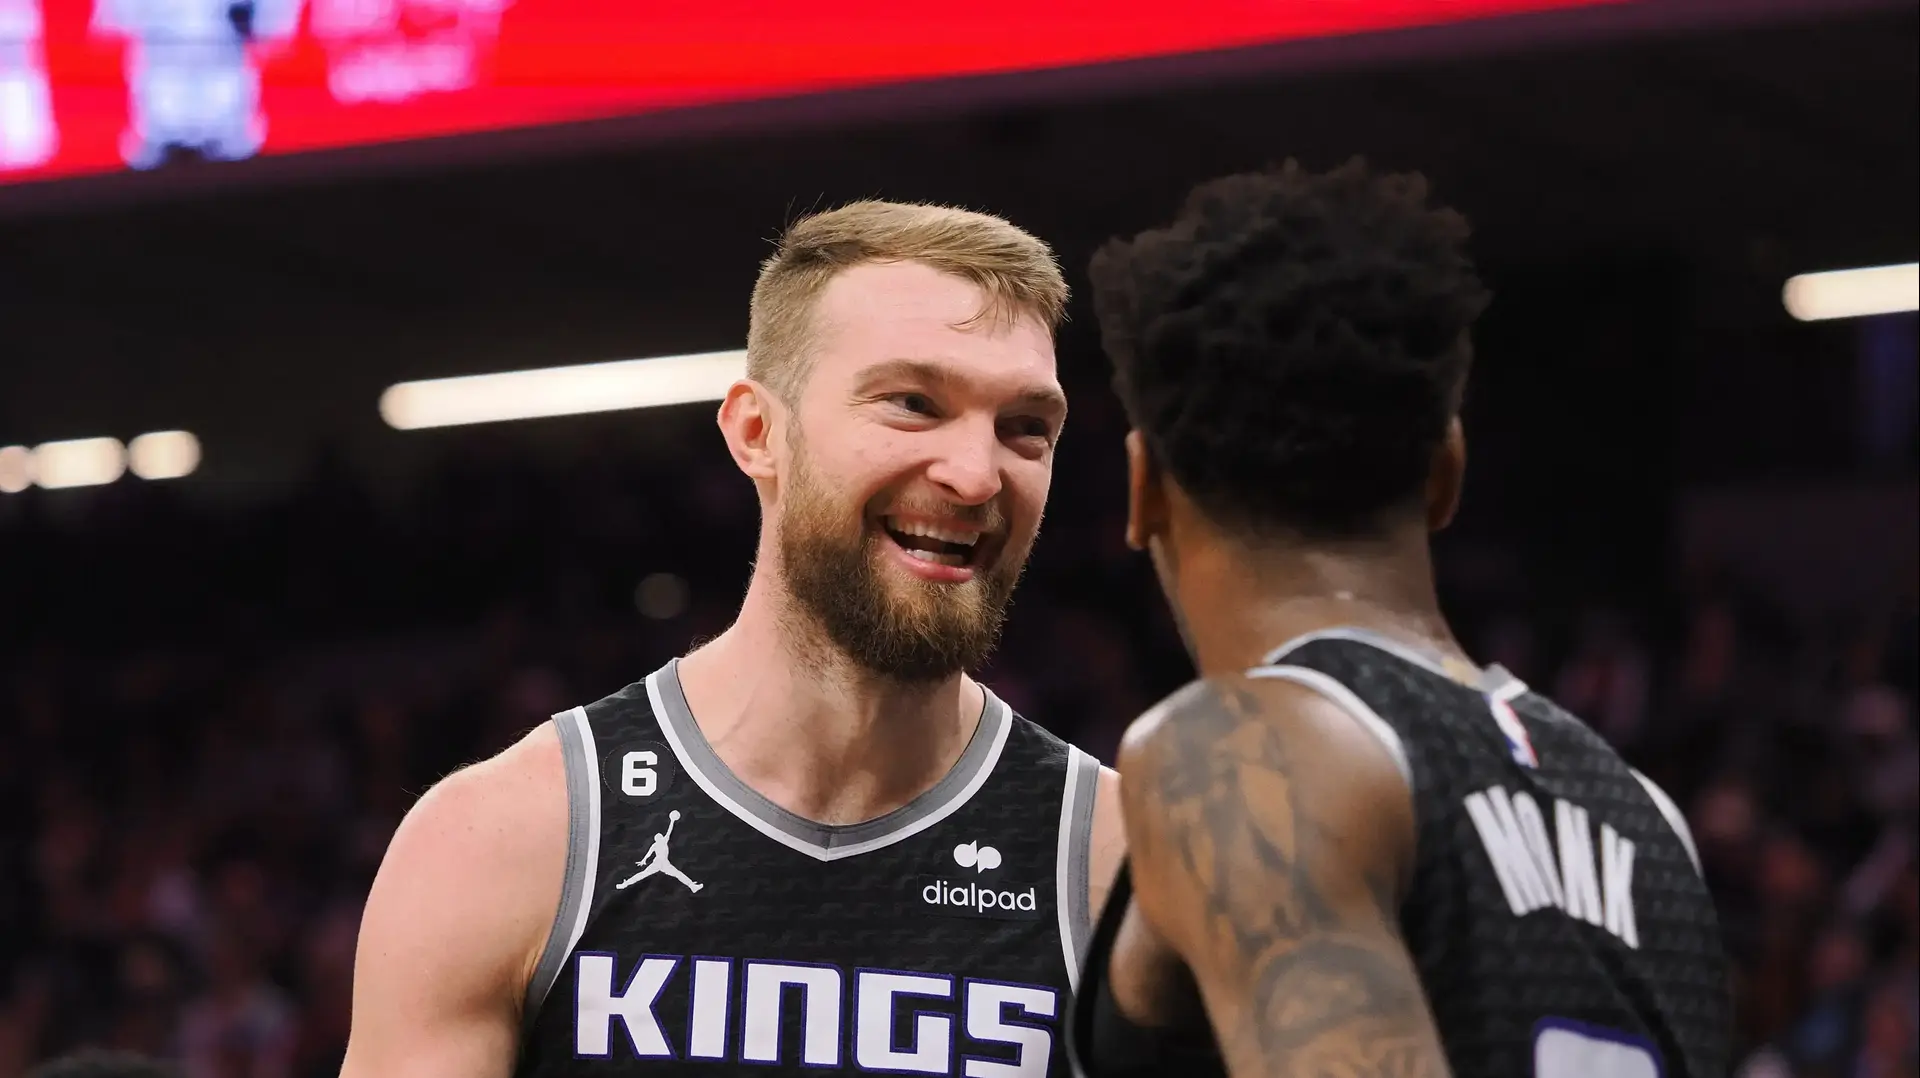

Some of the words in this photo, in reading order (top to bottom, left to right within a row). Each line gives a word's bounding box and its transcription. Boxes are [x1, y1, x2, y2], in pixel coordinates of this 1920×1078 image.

[621, 750, 658, 796] 6
[922, 880, 1036, 913] dialpad
[1464, 785, 1639, 949] MONK
[574, 951, 1058, 1078] KINGS
